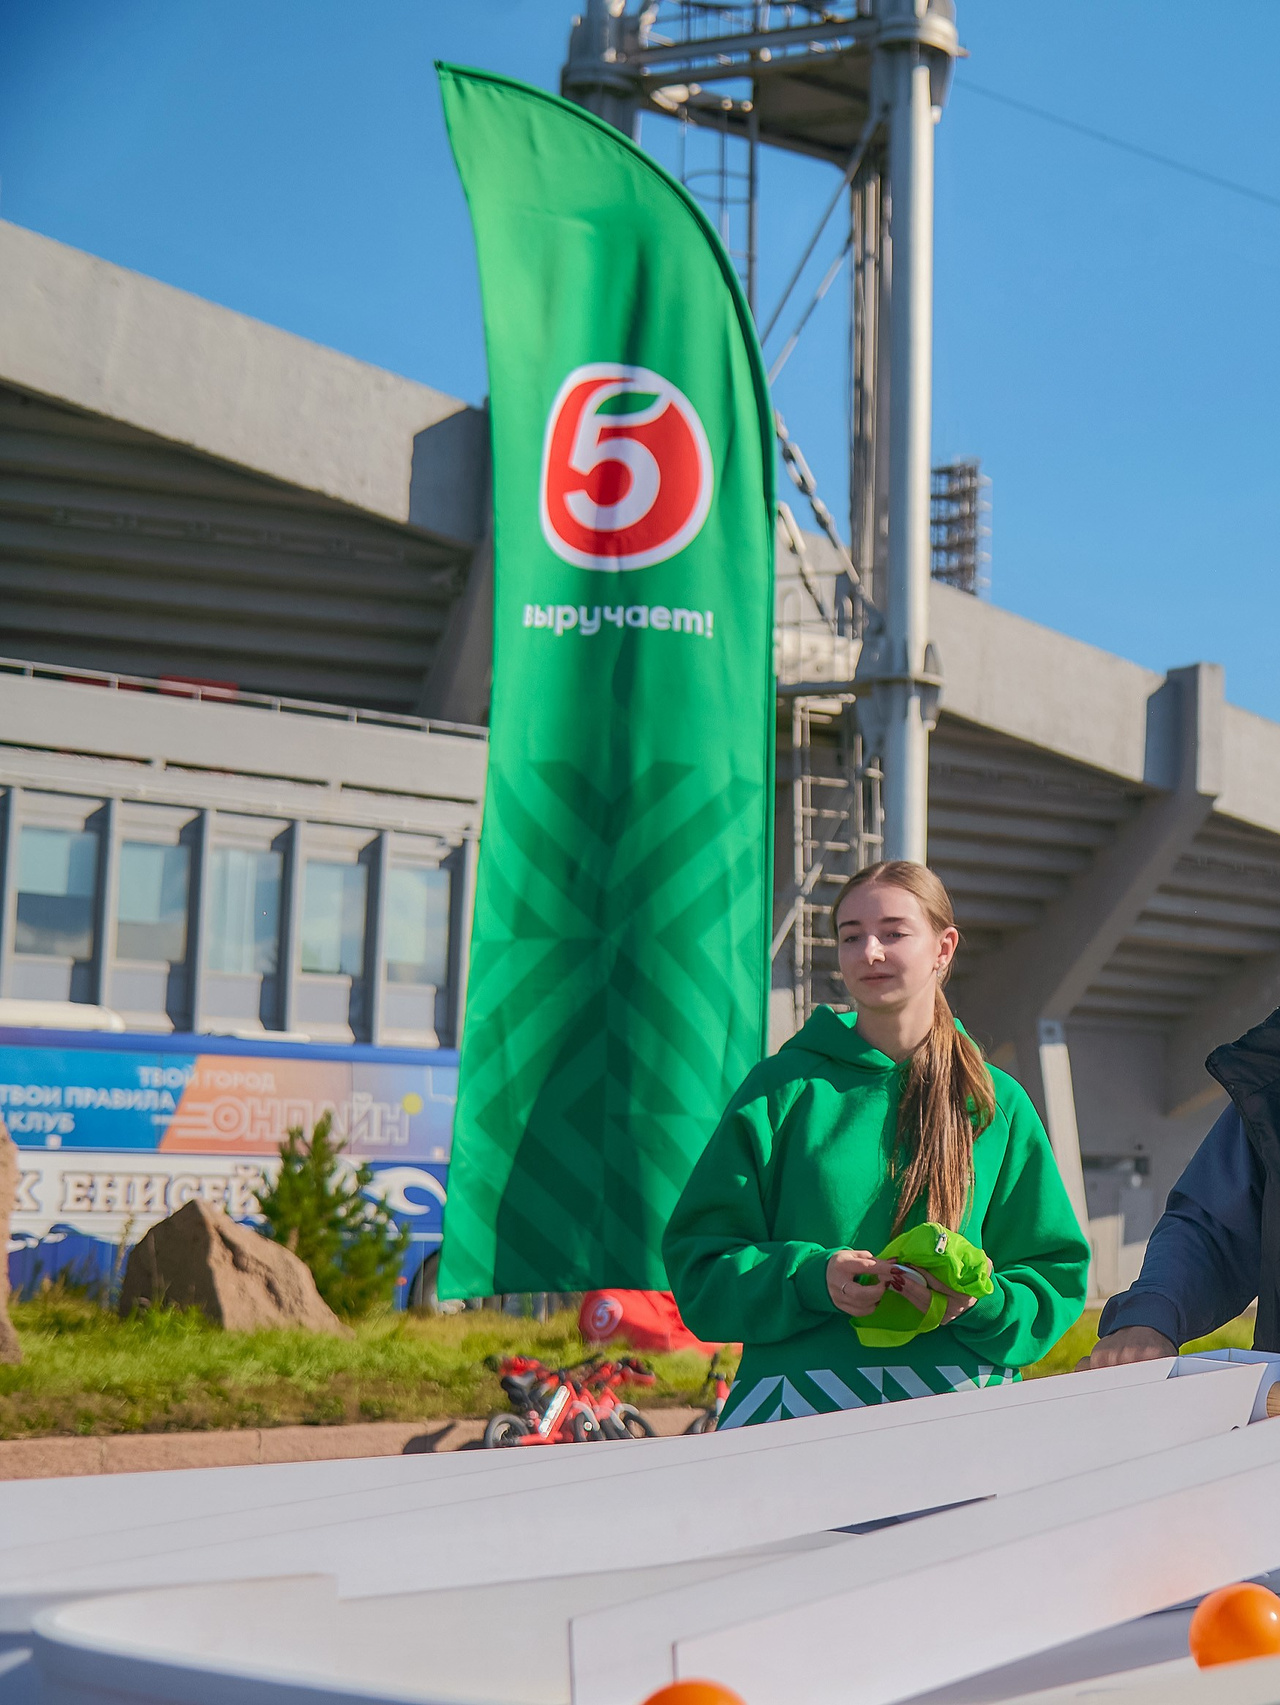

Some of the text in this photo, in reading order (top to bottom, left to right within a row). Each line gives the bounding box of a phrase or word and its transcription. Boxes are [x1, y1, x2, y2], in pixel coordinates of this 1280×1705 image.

[562, 381, 668, 532] 5
[204, 1070, 276, 1093] ГОРОД
[64, 1086, 176, 1111] ПРАВИЛА
[8, 1110, 75, 1134] КЛУБ
